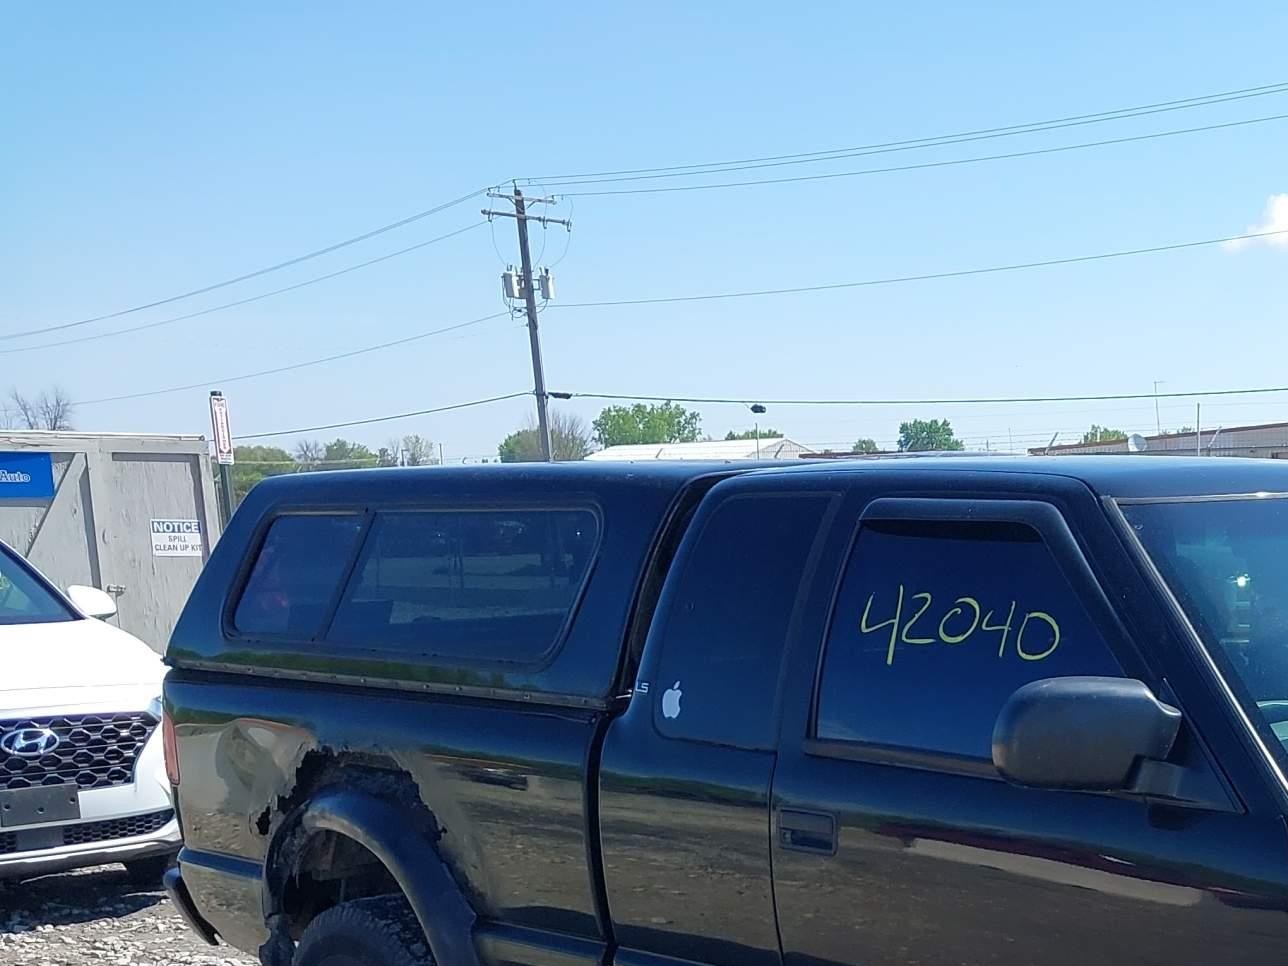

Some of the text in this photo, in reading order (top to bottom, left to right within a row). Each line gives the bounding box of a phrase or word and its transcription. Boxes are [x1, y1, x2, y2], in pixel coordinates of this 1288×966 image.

[153, 522, 199, 533] NOTICE
[168, 535, 187, 543] SPILL
[860, 584, 1060, 666] 42040
